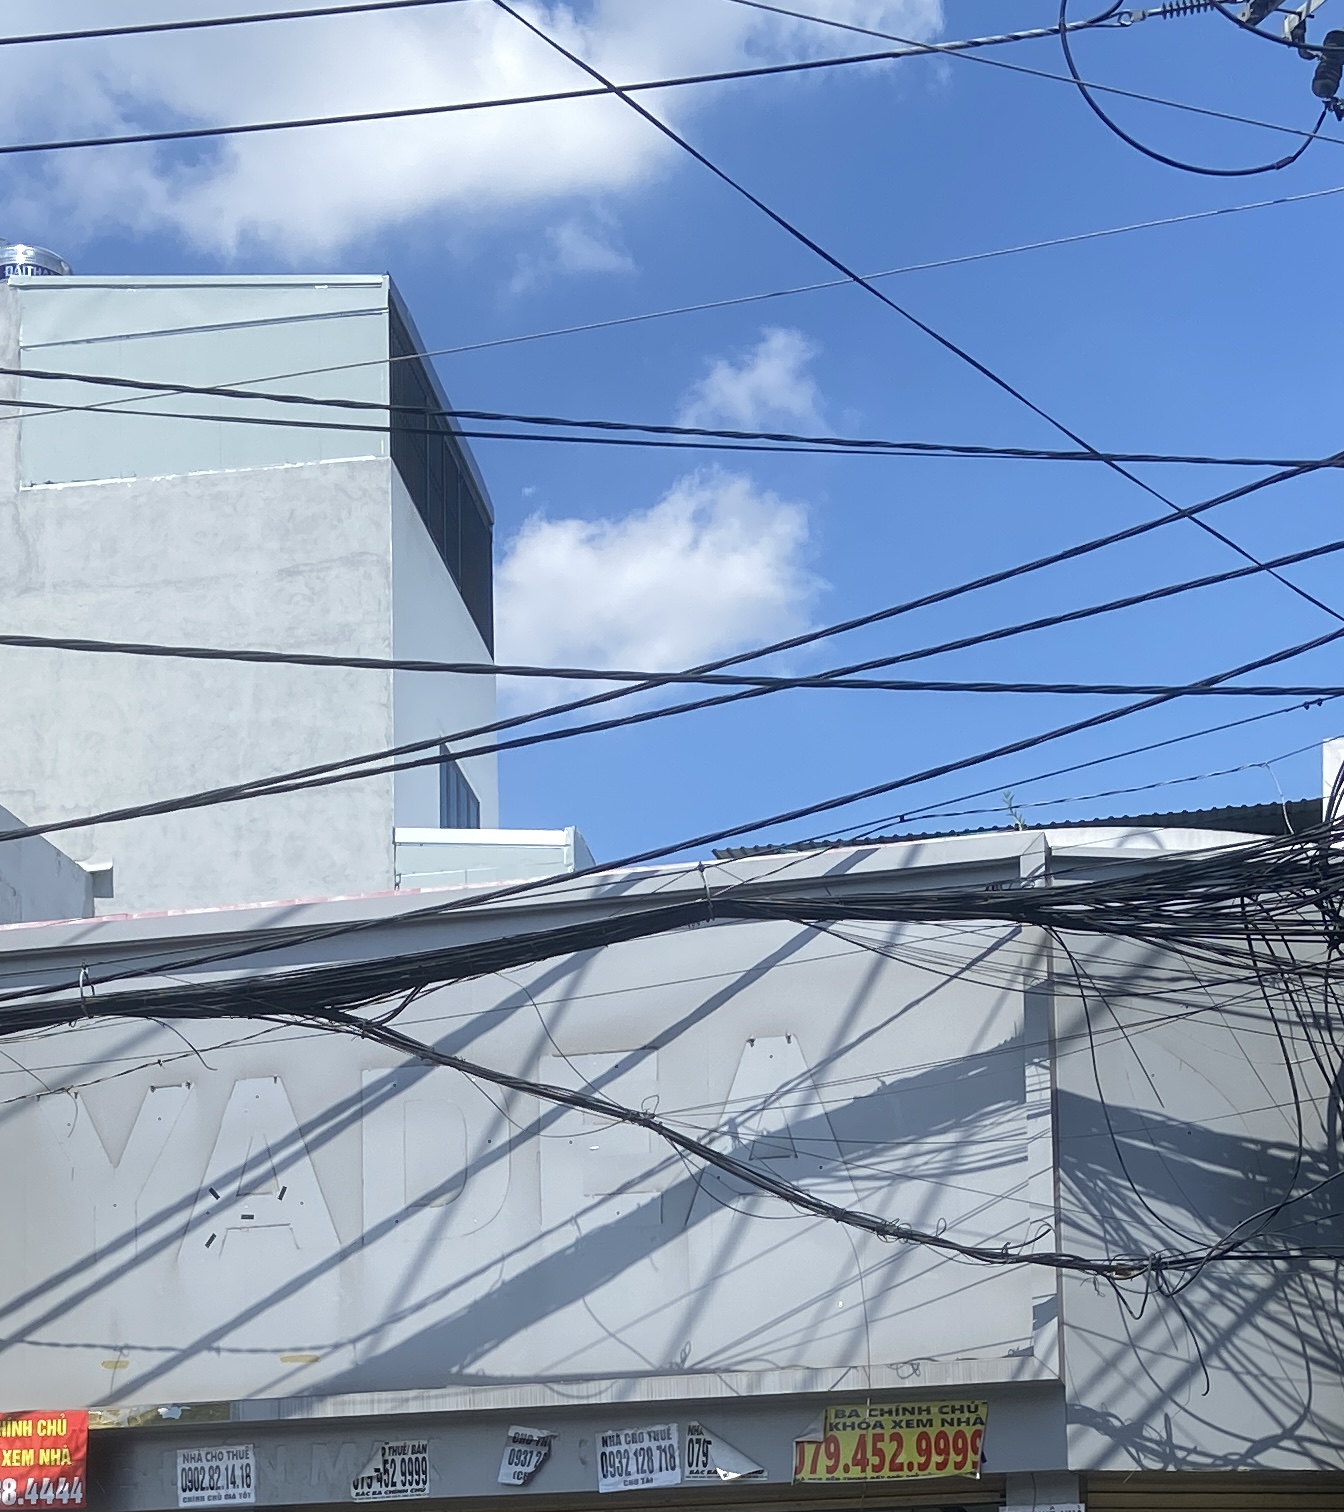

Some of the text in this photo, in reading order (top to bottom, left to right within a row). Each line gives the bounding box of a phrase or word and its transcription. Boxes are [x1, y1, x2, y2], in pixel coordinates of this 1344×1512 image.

[834, 1400, 979, 1419] BA CHÍNH CHỦ
[37, 1413, 67, 1437] CHỦ
[829, 1416, 986, 1432] KHÓA XEM NHÀ
[601, 1427, 672, 1448] NHÀ CHO THUÊ
[1, 1448, 35, 1467] XEM
[39, 1444, 73, 1466] NHÀ
[182, 1446, 250, 1464] NHÀ CHO THUÊ
[600, 1443, 677, 1479] 0932 128 718
[181, 1463, 252, 1493] 0902.82.14.18
[400, 1456, 428, 1487] 9999
